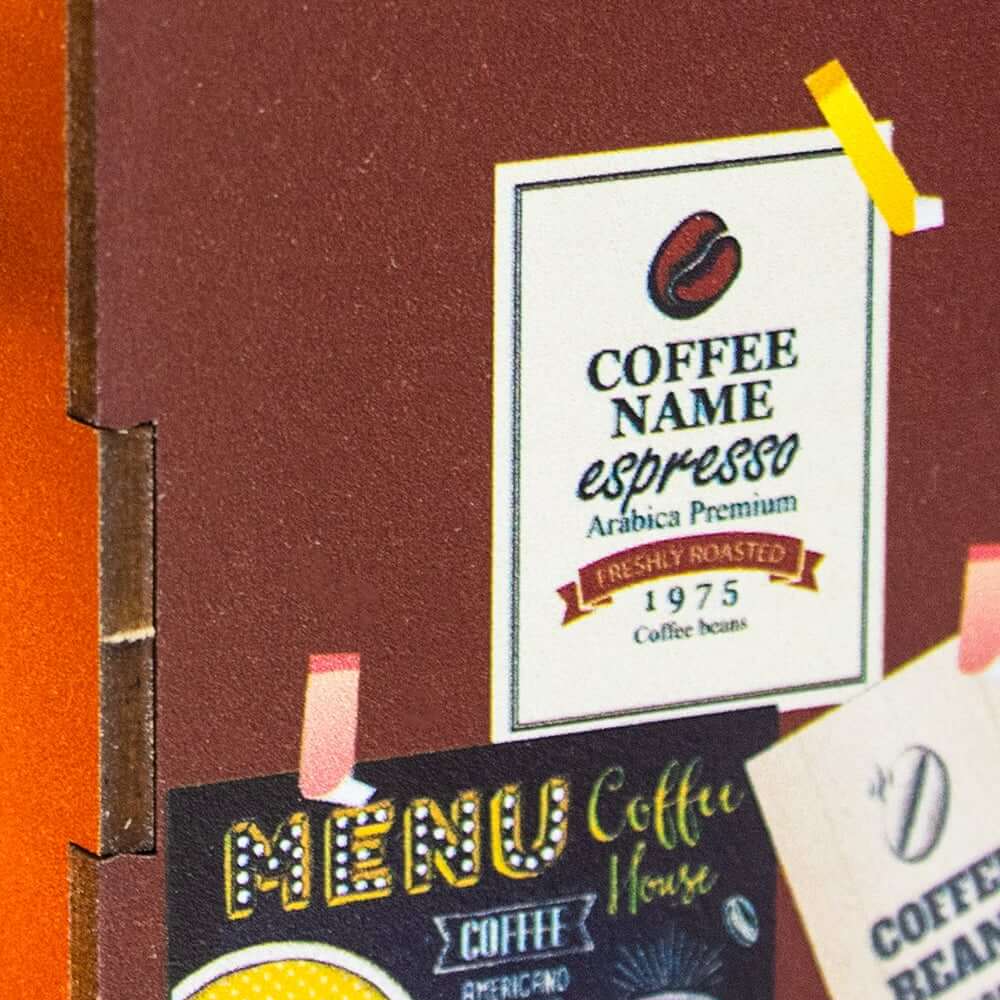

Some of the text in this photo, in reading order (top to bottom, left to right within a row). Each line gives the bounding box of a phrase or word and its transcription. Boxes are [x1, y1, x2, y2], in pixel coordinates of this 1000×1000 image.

[587, 328, 799, 390] COFFEE
[610, 380, 775, 438] NAME
[577, 432, 800, 515] espresso
[586, 492, 799, 538] Arabica Premium
[595, 542, 787, 586] FRESHLY ROASTED
[632, 614, 749, 645] Coffee beans
[587, 759, 746, 850] Coffee
[224, 776, 571, 921] MENU
[607, 841, 718, 915] House
[460, 906, 569, 962] COFFEE
[871, 847, 1000, 960] COFFE
